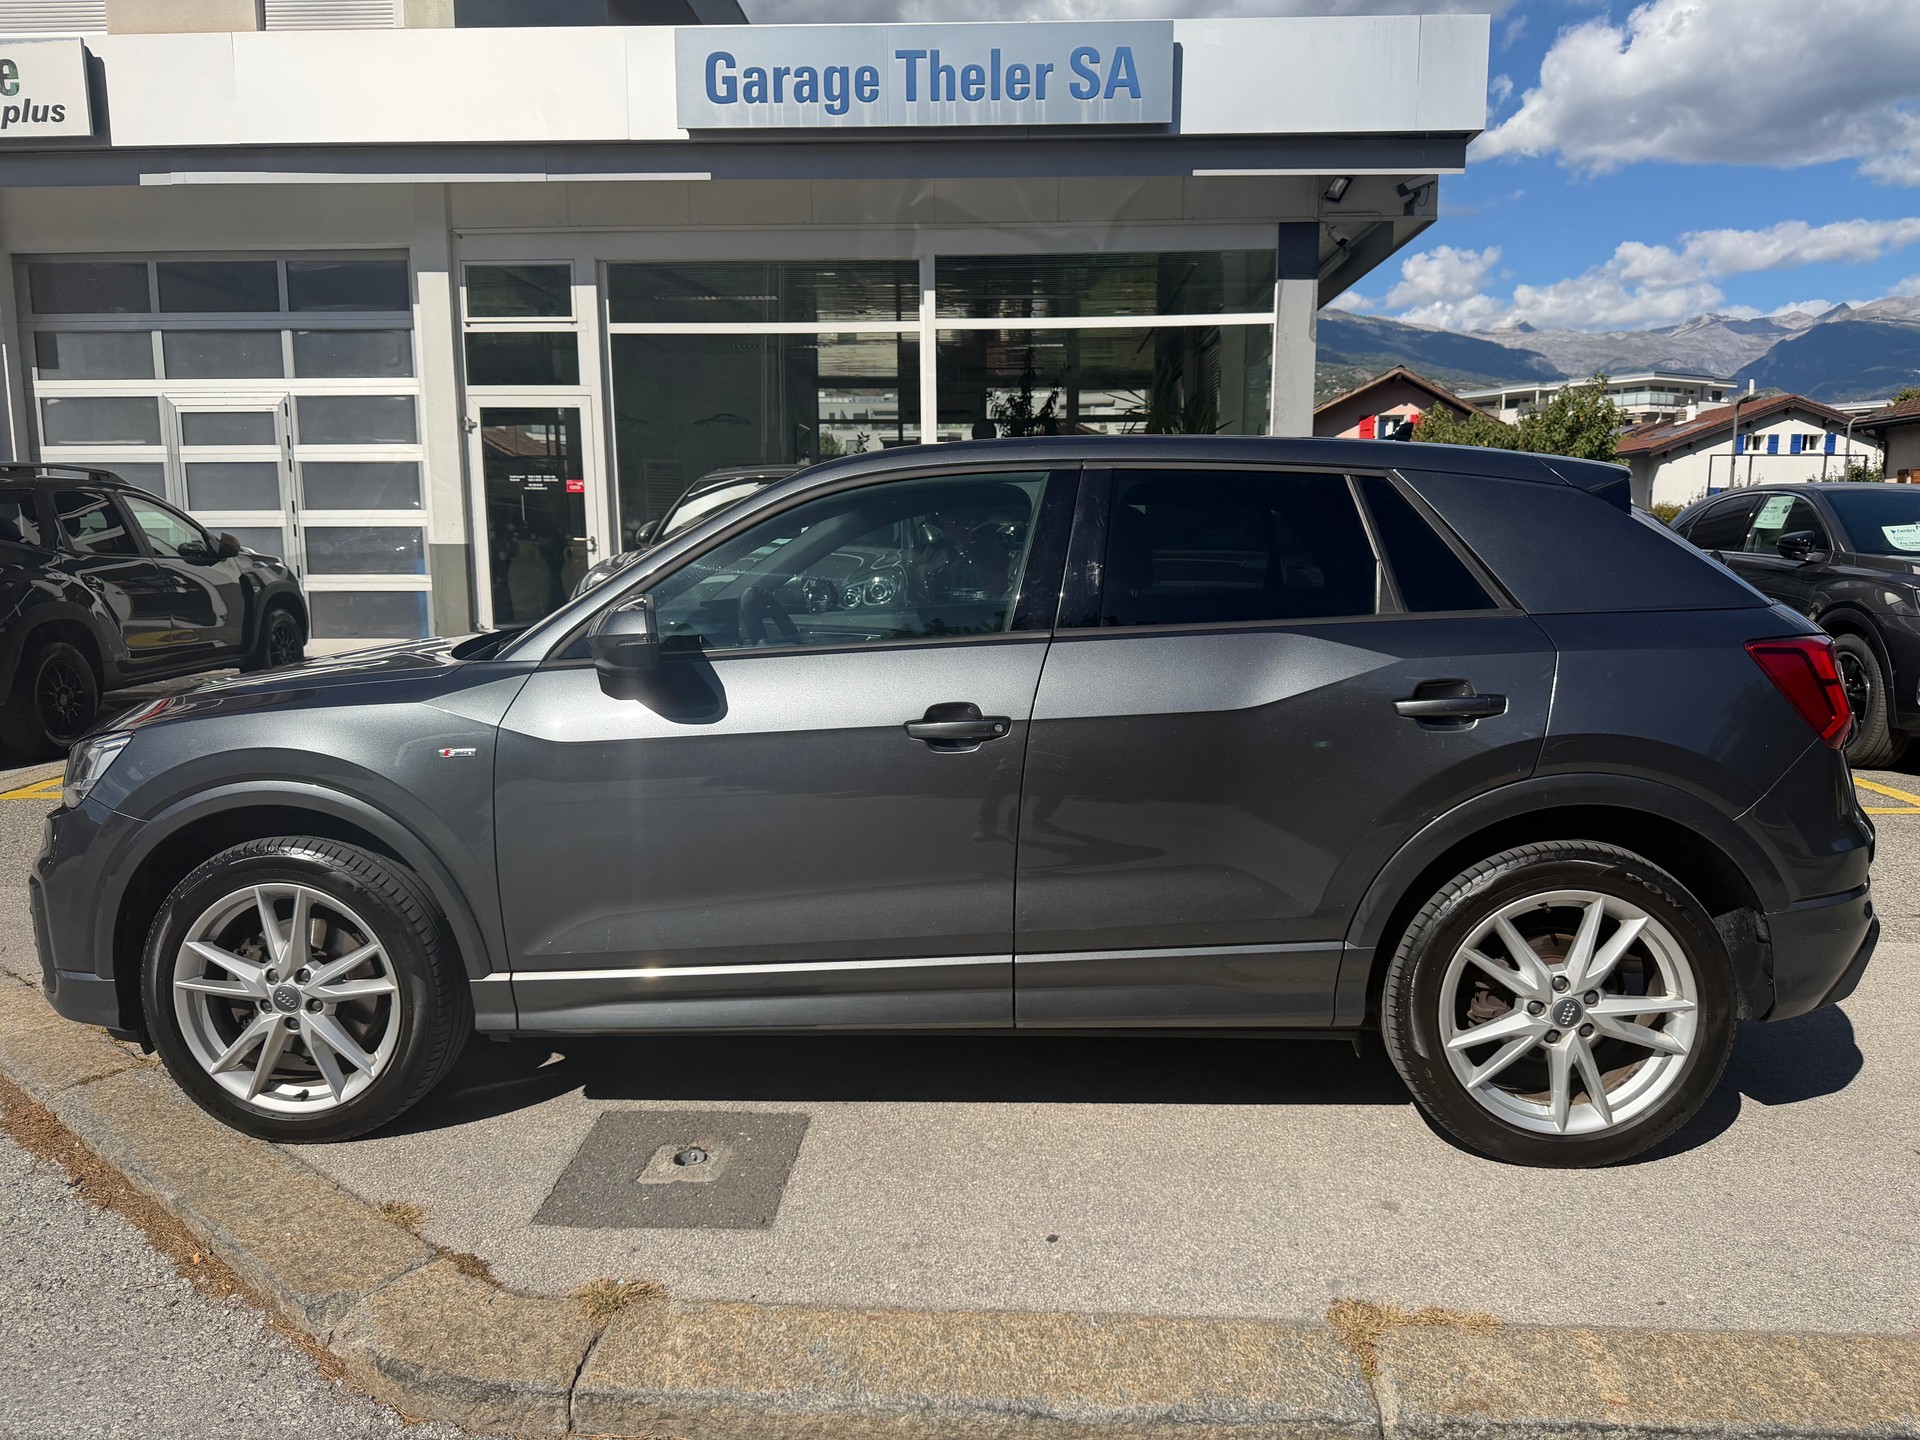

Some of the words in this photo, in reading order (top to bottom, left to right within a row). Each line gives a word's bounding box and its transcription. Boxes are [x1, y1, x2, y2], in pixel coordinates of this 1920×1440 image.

[704, 51, 880, 116] Garage
[895, 48, 1054, 102] Theler
[1069, 46, 1142, 101] SA
[1, 98, 66, 129] plus
